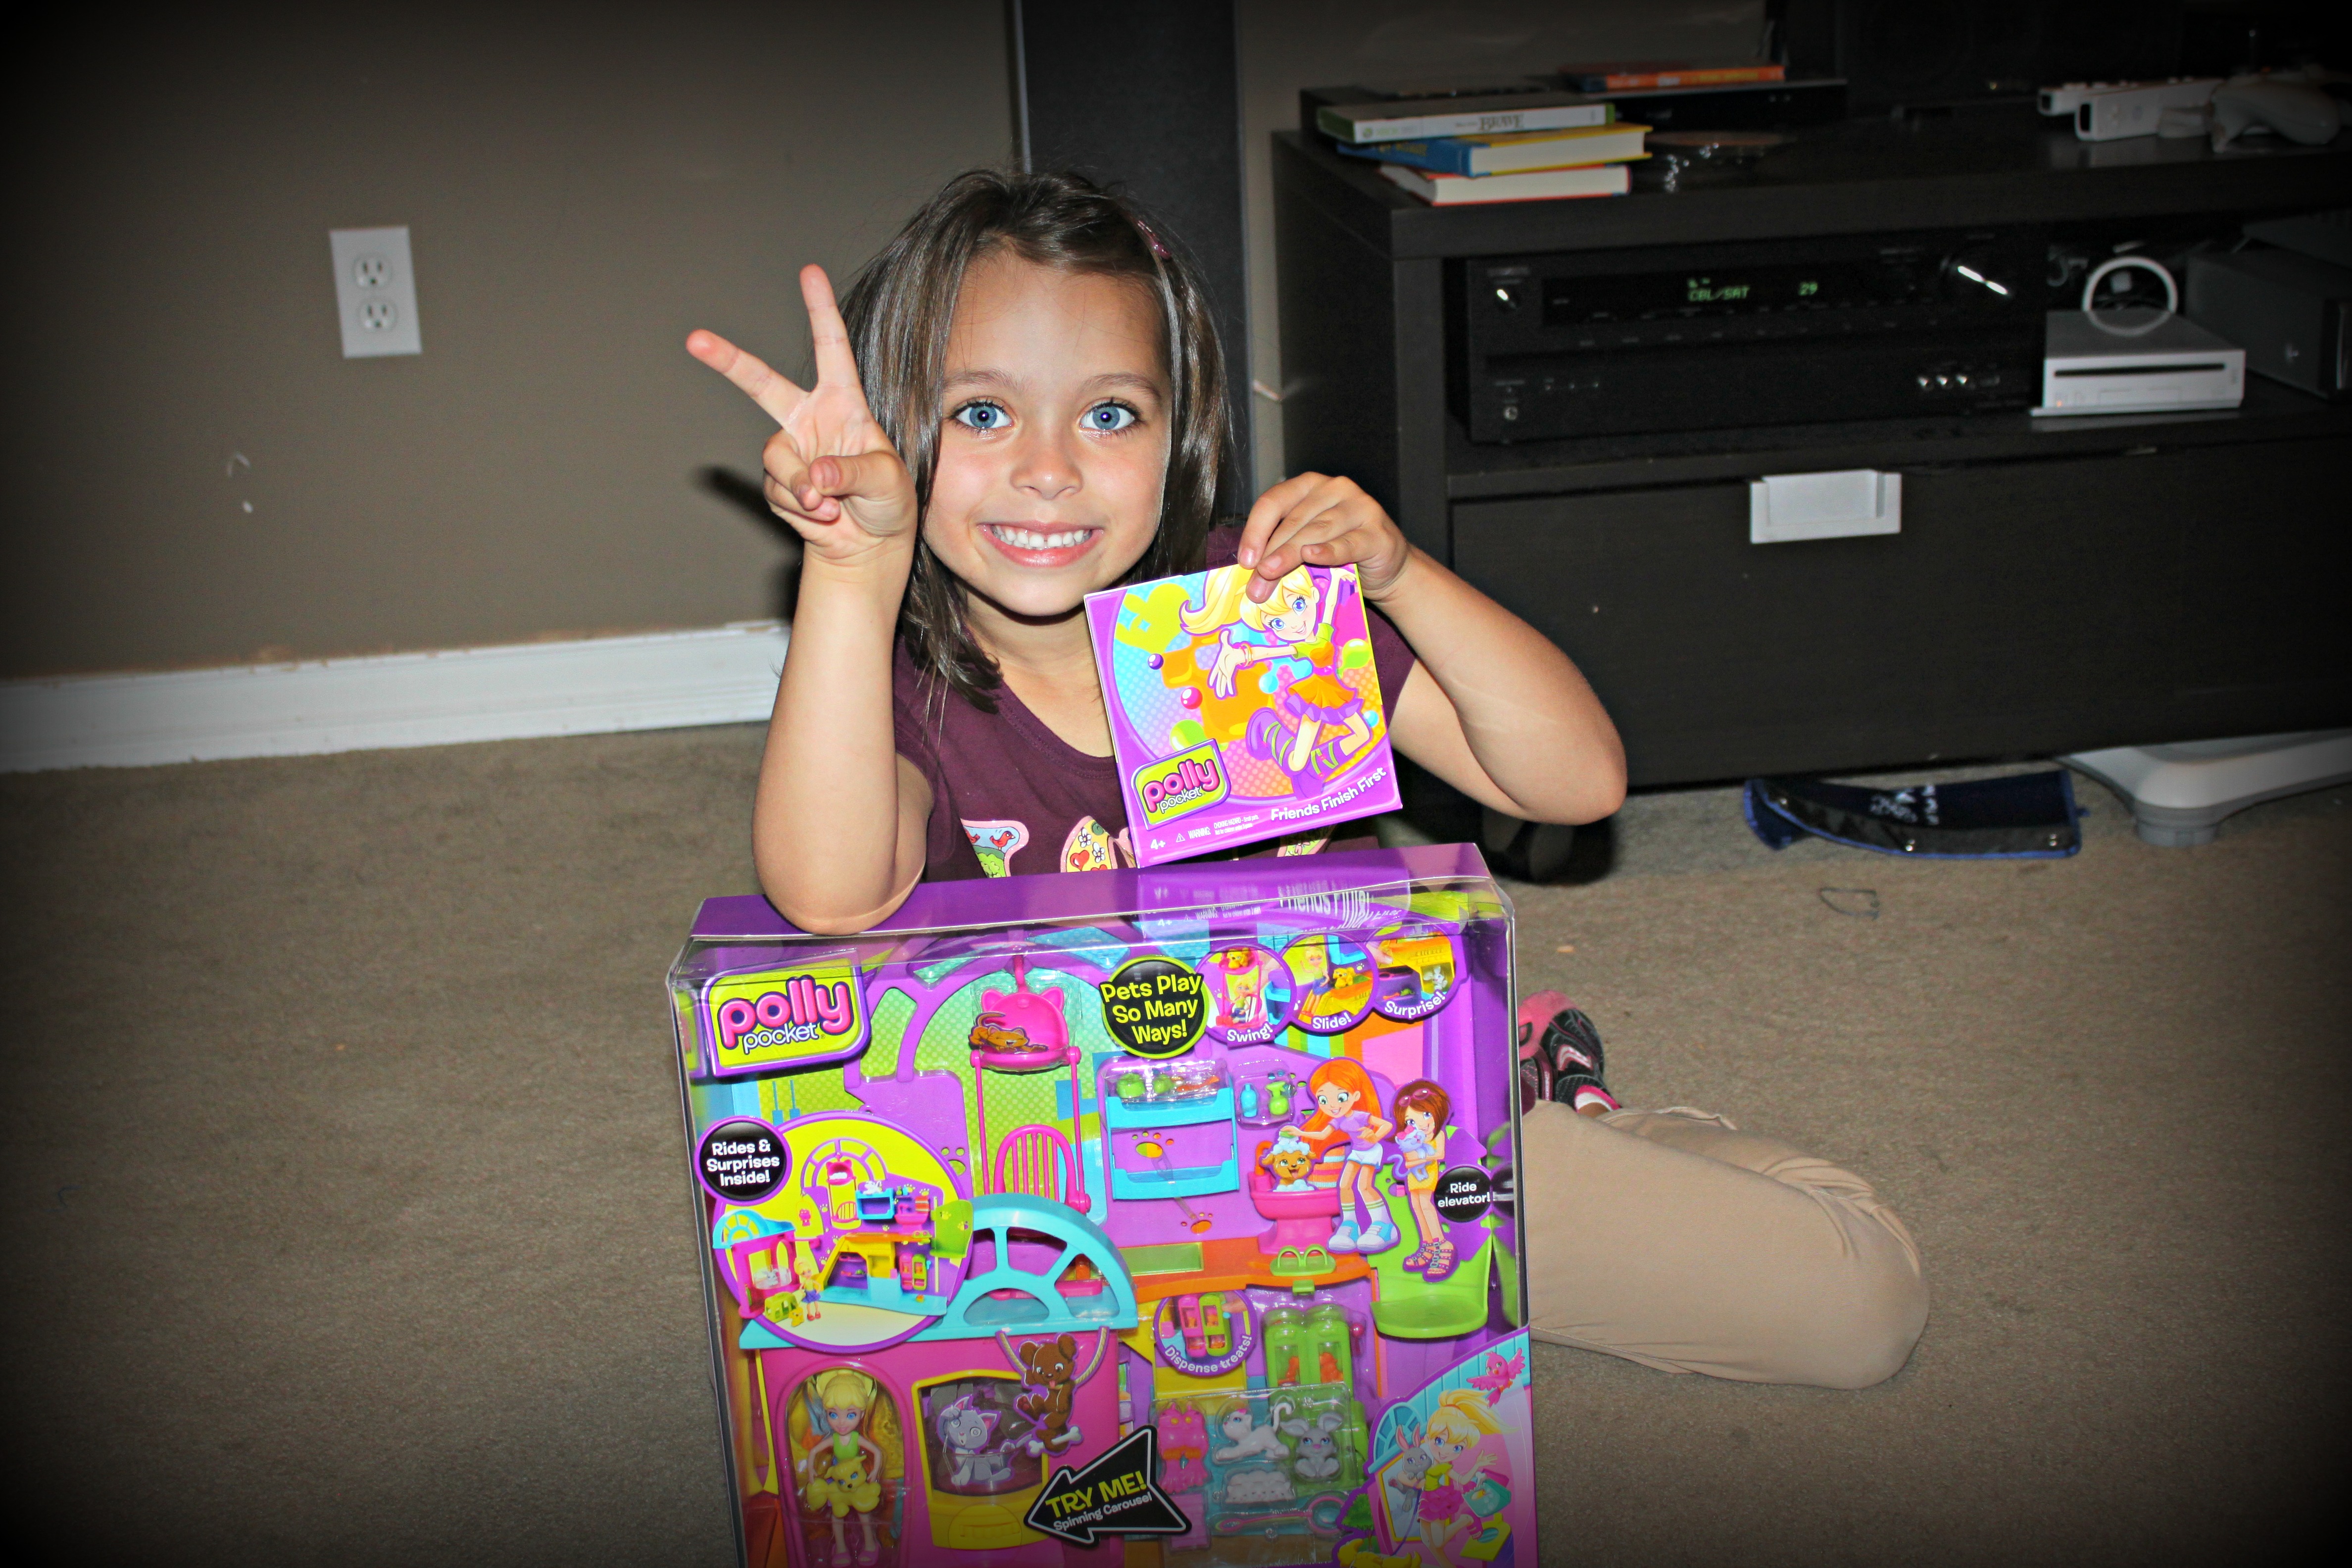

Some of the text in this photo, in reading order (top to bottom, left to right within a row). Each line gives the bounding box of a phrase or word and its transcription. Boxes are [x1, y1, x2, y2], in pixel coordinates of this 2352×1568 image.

[1799, 281, 1818, 296] 29
[1142, 759, 1220, 813] polly
[1271, 767, 1387, 821] Friends Finish First
[1160, 786, 1203, 814] pocket
[1150, 839, 1166, 850] 4+
[1100, 974, 1202, 1002] Pets Play
[718, 975, 854, 1049] polly
[1112, 999, 1198, 1024] So Many
[1384, 991, 1446, 1019] Surprise!
[1131, 1019, 1187, 1045] Ways!
[1226, 1023, 1274, 1043] Swing!
[1312, 1012, 1352, 1030] Slide!
[742, 1023, 819, 1055] pocket
[712, 1138, 771, 1156] Rides &
[706, 1155, 781, 1173] Surprises
[720, 1170, 771, 1186] Inside!
[1450, 1182, 1477, 1193] Ride
[1437, 1191, 1491, 1208] elevator!
[1165, 1335, 1252, 1373] Dispense treats!
[1045, 1470, 1147, 1518] TRY ME!
[1053, 1491, 1153, 1531] Spinning Carousel
